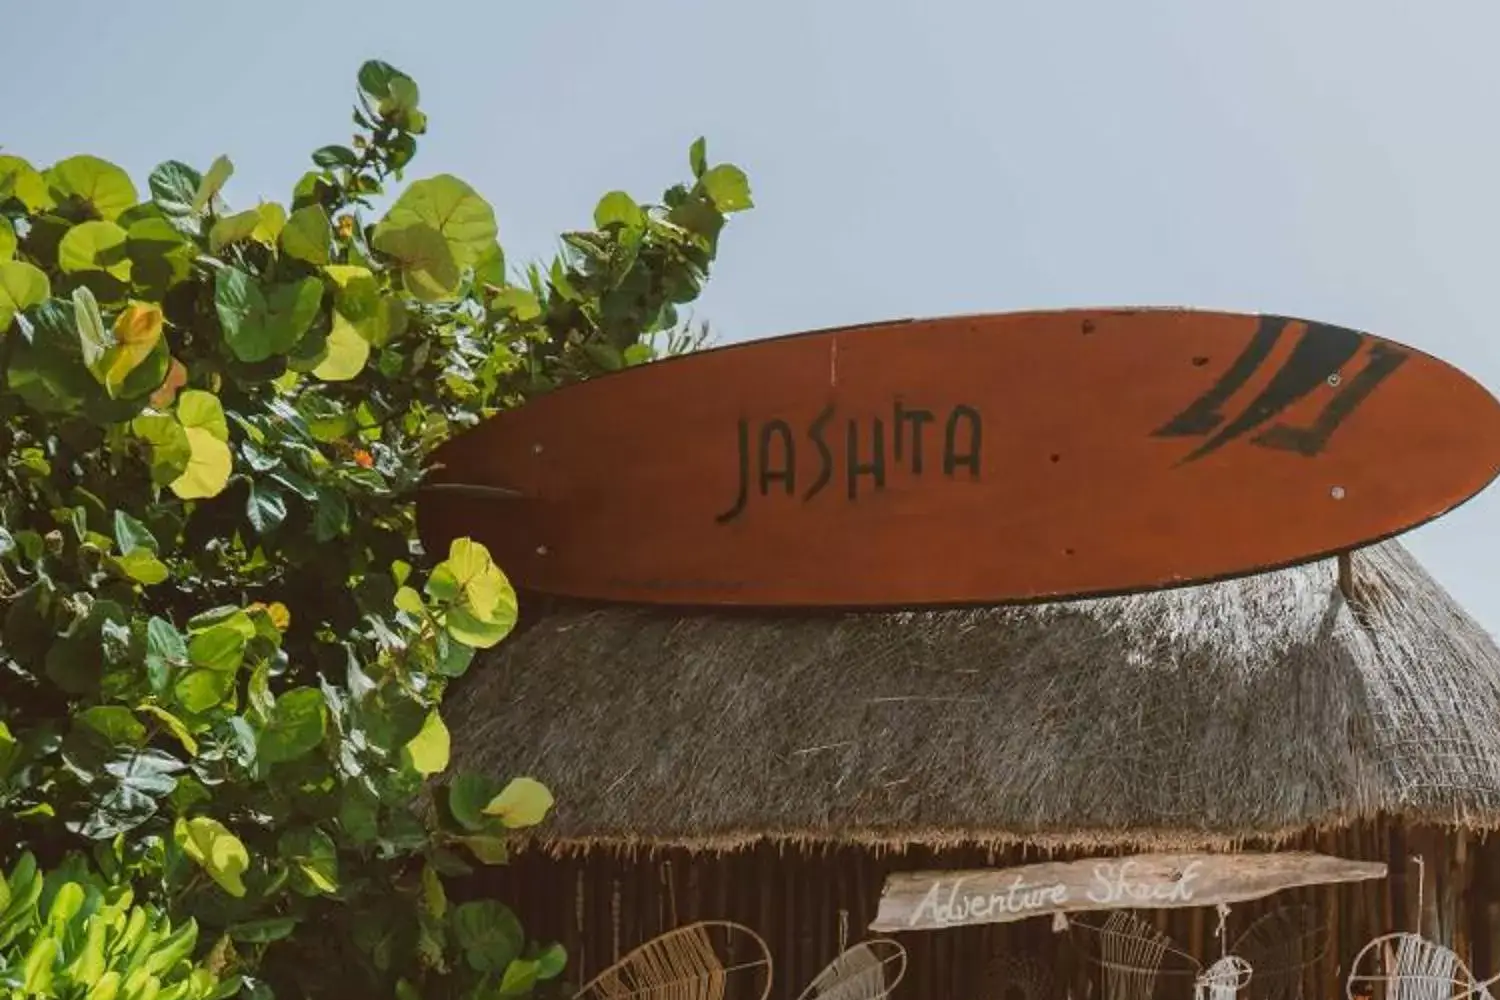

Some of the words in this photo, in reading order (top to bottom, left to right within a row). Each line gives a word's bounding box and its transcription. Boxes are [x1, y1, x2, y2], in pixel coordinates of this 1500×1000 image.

[715, 397, 983, 524] JASHITA
[909, 874, 1067, 928] Adventure
[1086, 861, 1203, 903] Shack
